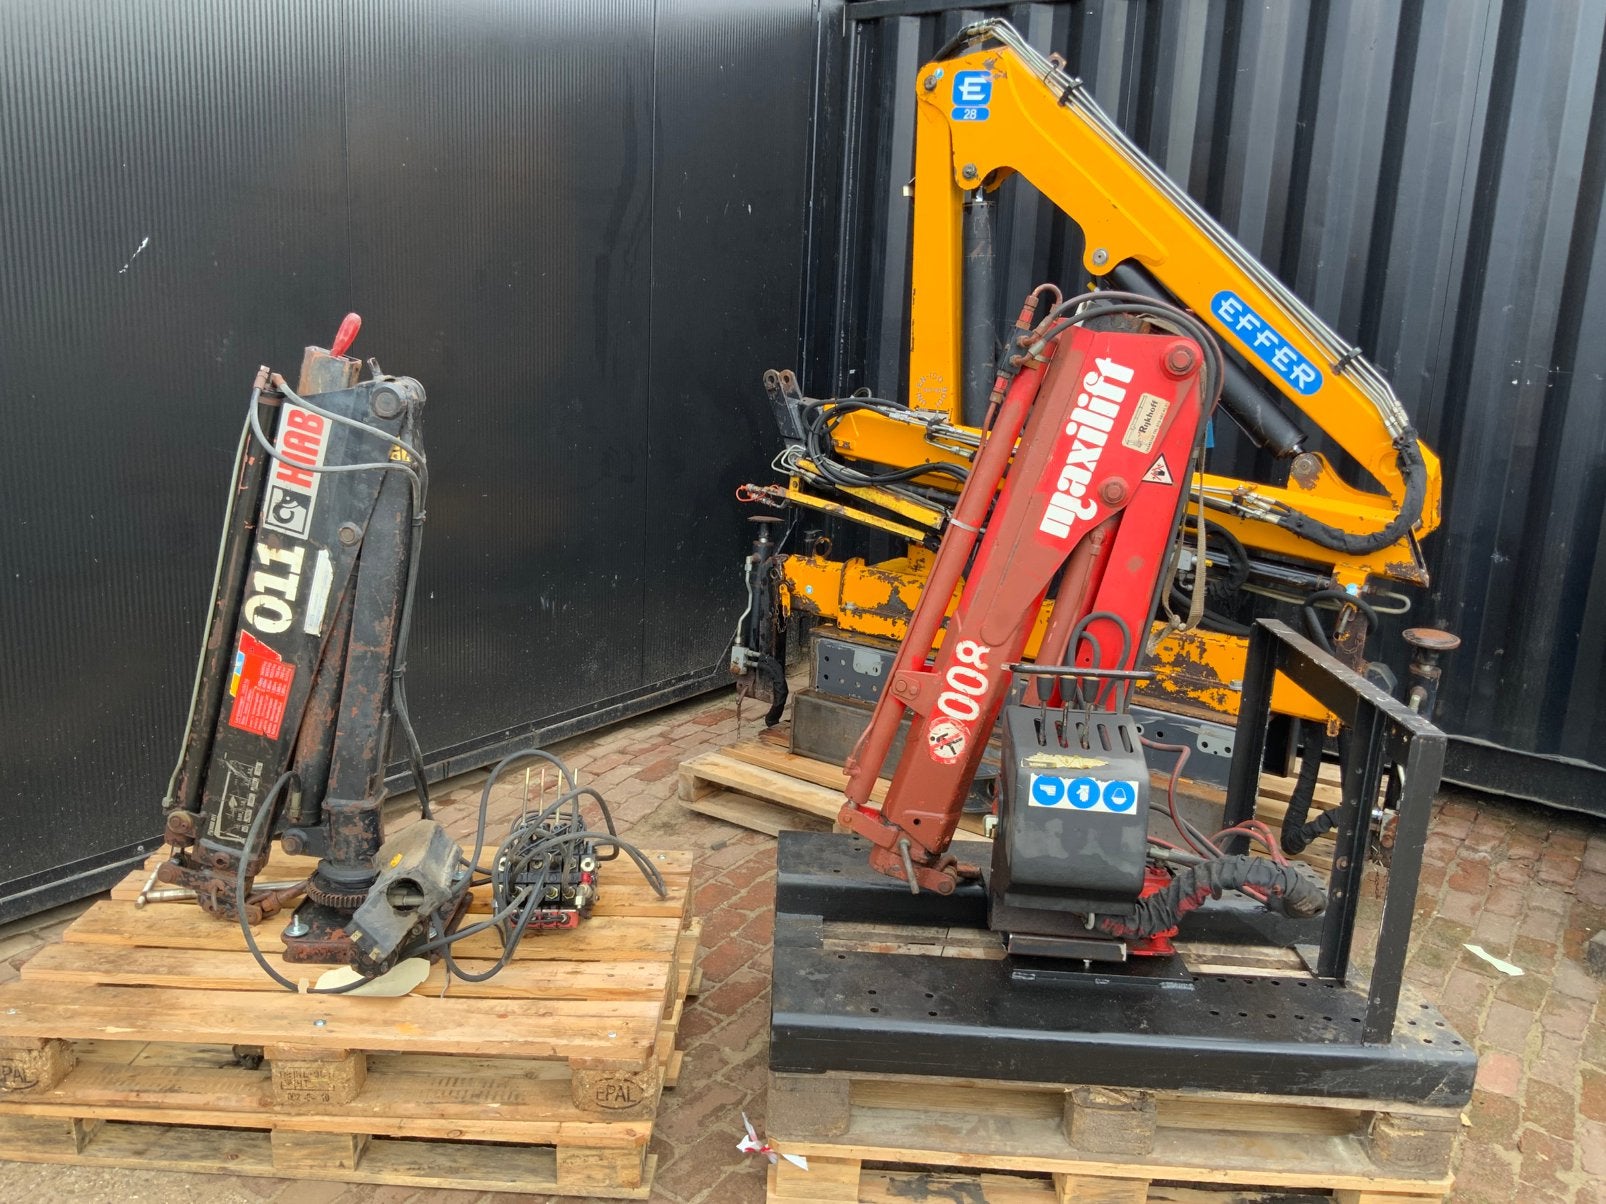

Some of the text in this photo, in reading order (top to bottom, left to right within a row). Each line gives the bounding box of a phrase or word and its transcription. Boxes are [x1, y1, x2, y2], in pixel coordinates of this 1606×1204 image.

[963, 108, 977, 120] 28
[1218, 297, 1316, 390] EFFER
[276, 408, 326, 489] HIAB
[1039, 357, 1135, 539] maxilift
[244, 543, 305, 634] 011
[1, 1065, 34, 1084] PAL
[596, 1083, 637, 1103] EPAL
